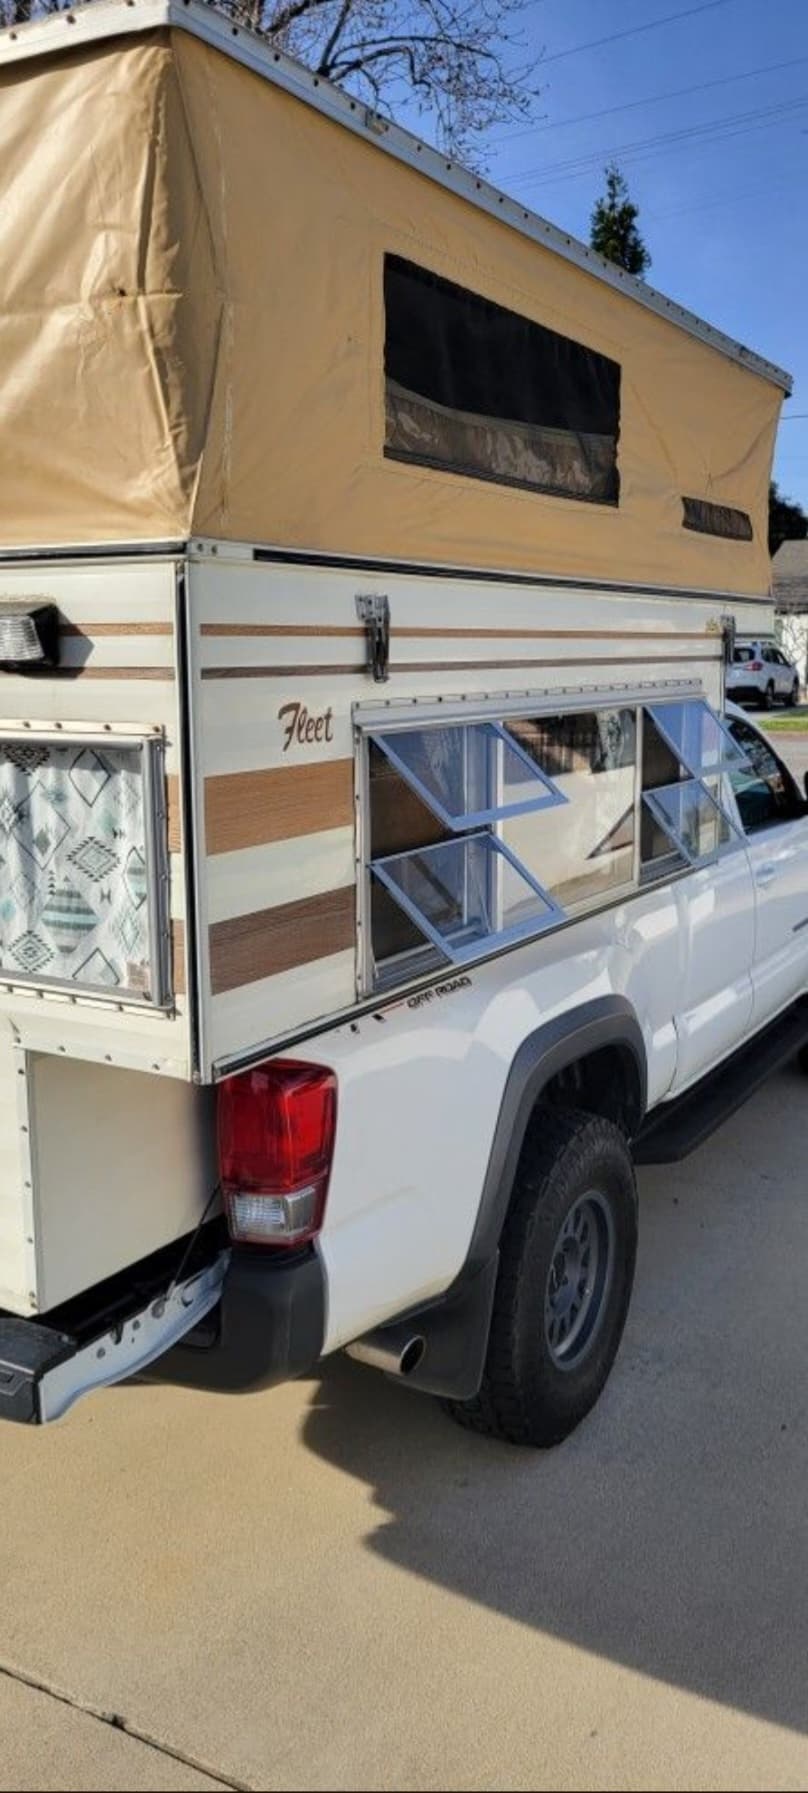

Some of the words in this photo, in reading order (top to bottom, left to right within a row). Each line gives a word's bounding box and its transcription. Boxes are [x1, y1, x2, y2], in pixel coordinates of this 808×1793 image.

[278, 702, 333, 752] Fleet
[406, 990, 434, 1008] OFF
[435, 976, 472, 998] ROAD
